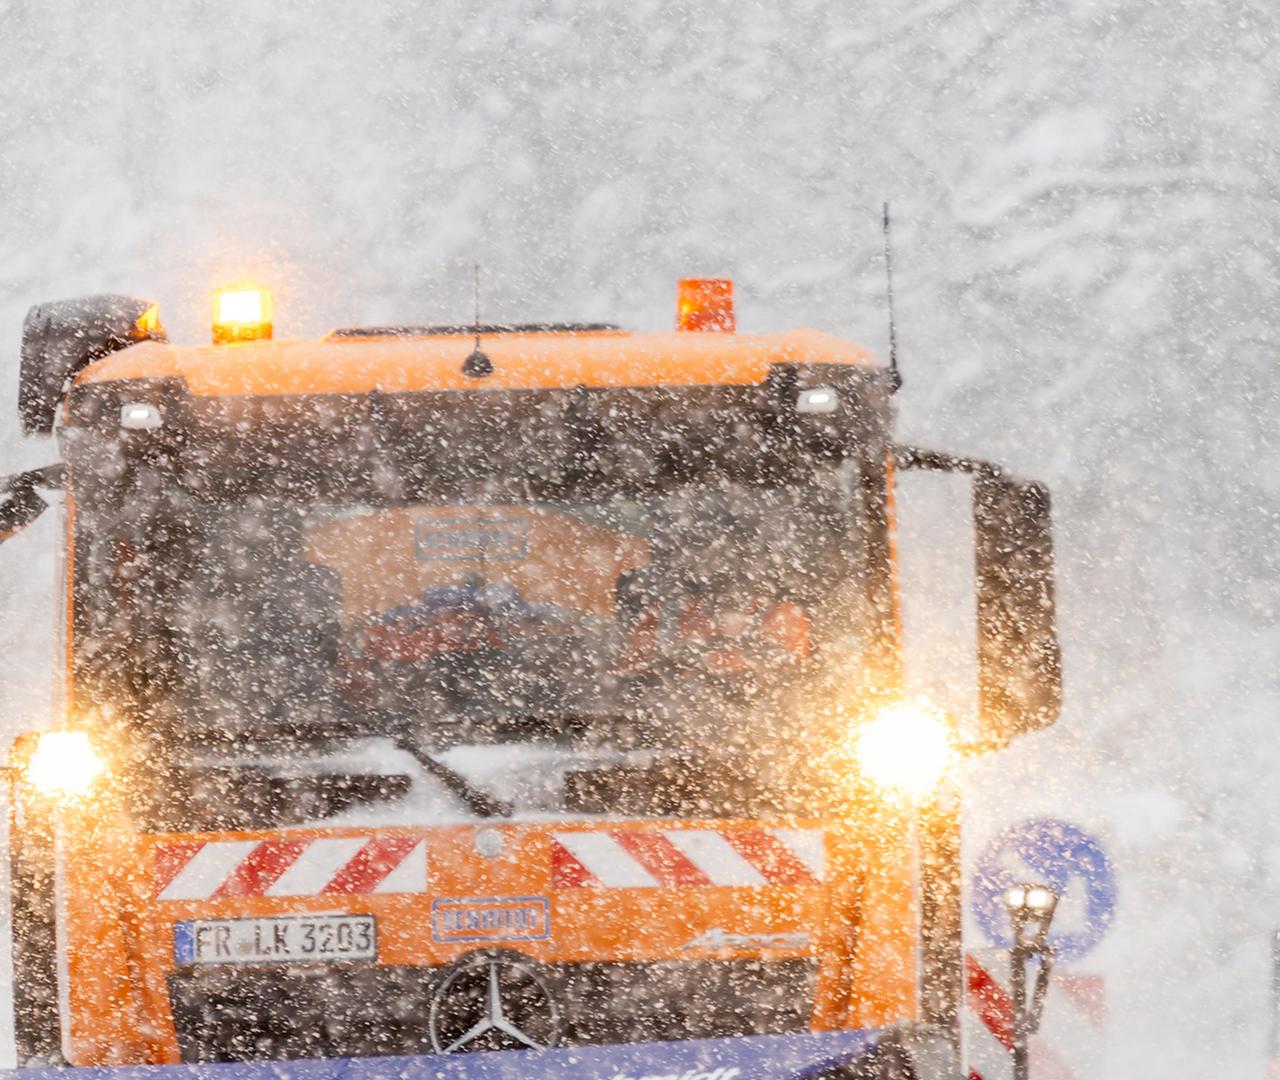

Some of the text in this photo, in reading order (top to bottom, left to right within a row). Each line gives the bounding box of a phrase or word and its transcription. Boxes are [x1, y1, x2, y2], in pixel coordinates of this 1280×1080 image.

[195, 925, 232, 957] FR
[254, 924, 291, 955] LK
[300, 921, 372, 954] 3203
